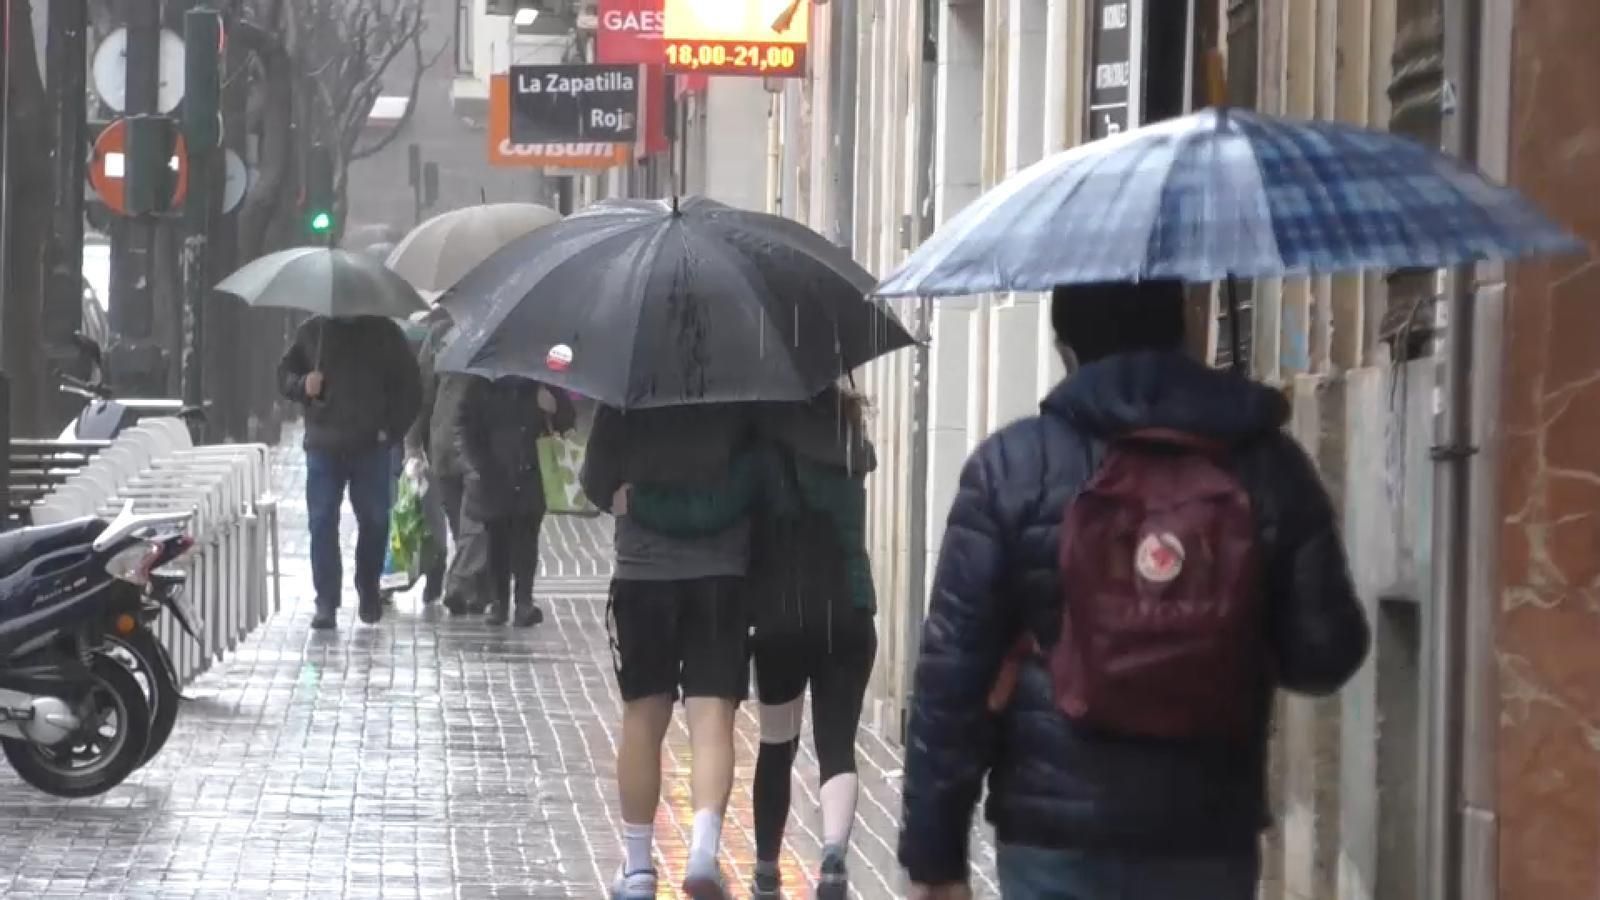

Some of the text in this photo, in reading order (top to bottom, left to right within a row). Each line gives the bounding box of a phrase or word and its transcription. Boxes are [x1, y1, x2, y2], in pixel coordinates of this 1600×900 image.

[665, 43, 795, 70] 18,00-21,00
[518, 71, 634, 97] La Zapatilla
